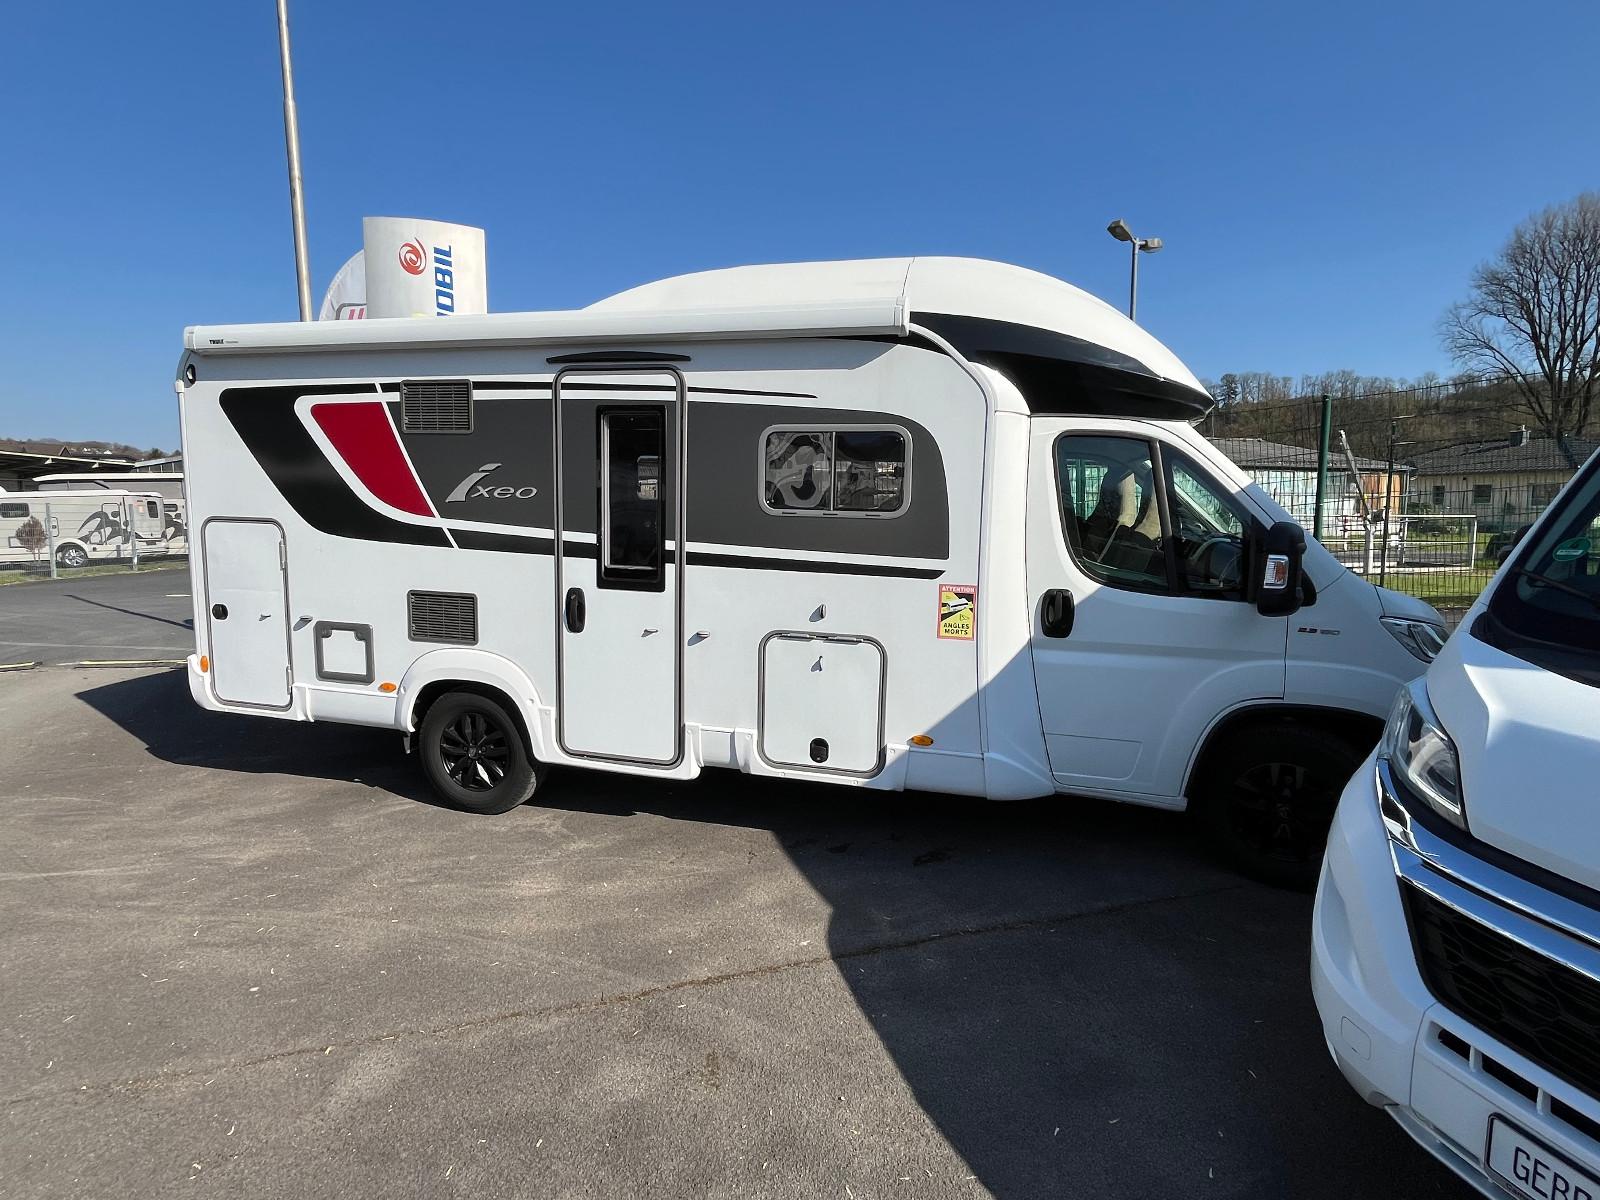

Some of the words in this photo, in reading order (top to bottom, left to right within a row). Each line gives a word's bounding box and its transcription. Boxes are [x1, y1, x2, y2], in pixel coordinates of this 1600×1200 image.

[433, 245, 455, 317] OBIL
[941, 585, 975, 593] ATTENTION
[943, 622, 970, 630] ANGLES
